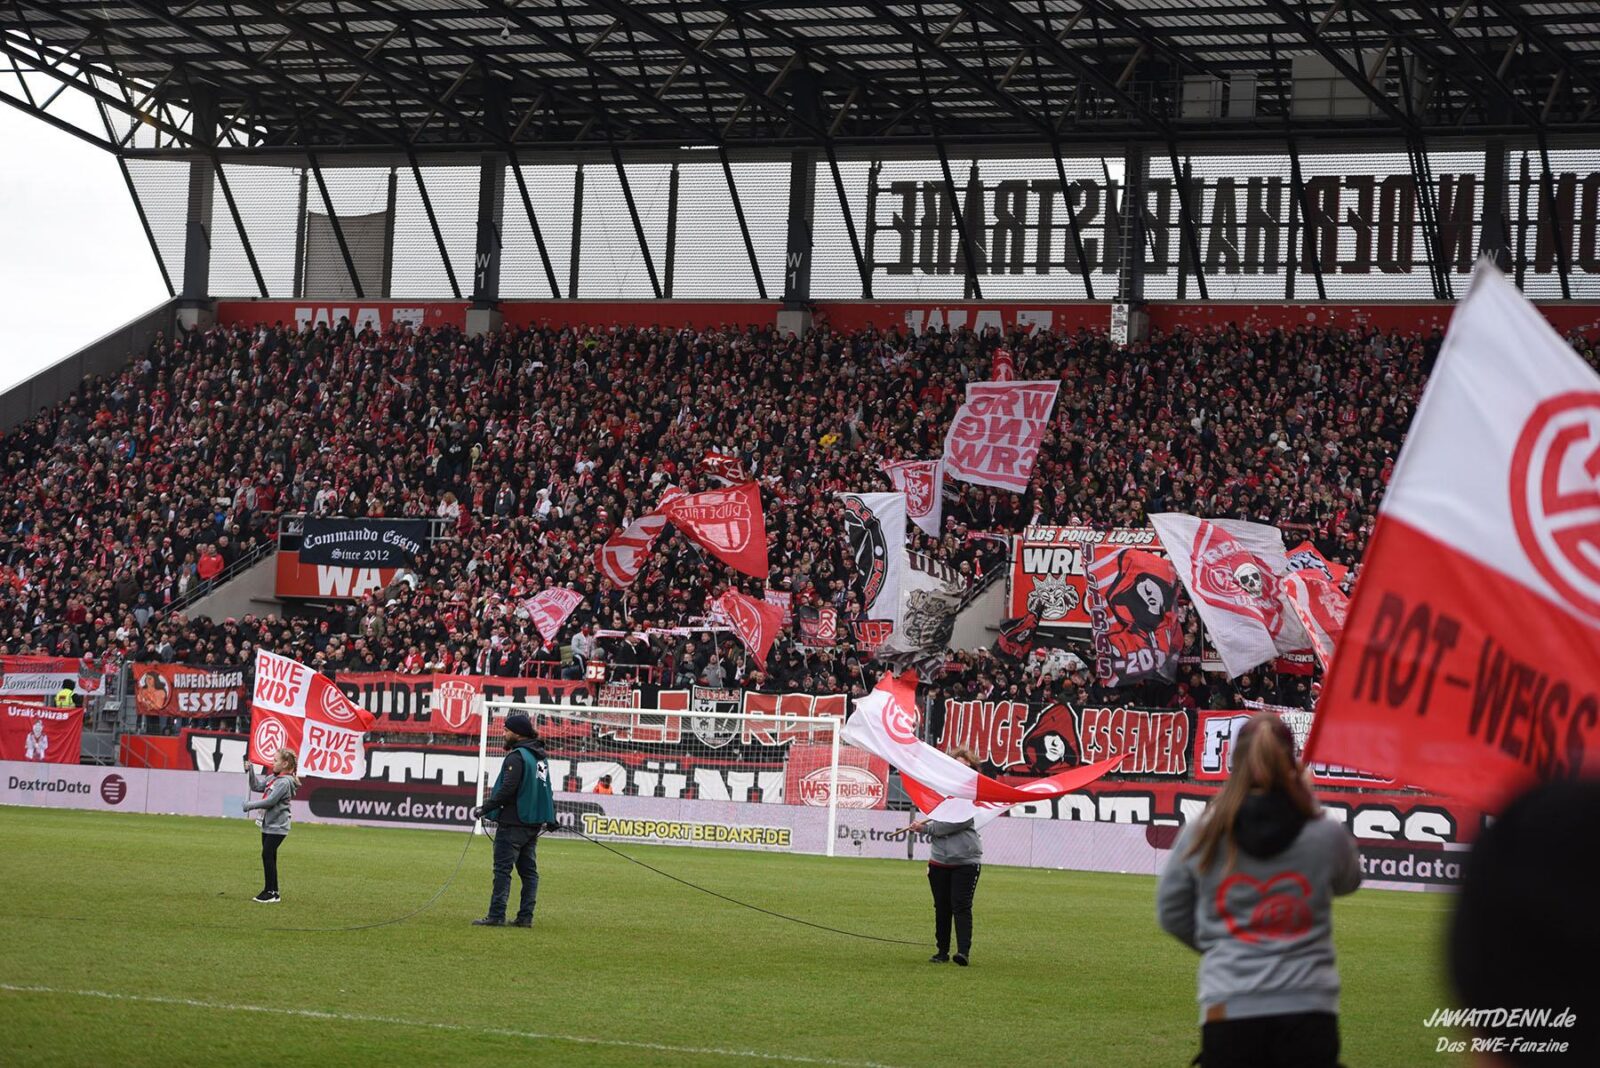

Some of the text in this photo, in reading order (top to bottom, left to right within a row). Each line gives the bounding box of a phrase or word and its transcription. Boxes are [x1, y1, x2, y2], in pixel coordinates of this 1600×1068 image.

[304, 527, 420, 555] Commando Essen
[1027, 528, 1056, 542] LOS
[1106, 530, 1157, 544] LOCOS
[331, 548, 390, 561] Since 2012
[317, 564, 404, 598] WA
[3, 675, 63, 690] Kommiliton
[258, 654, 306, 686] RWE
[178, 691, 239, 712] ESSEN
[255, 677, 300, 708] KIDS
[309, 726, 359, 753] RWE
[937, 698, 1029, 769] JUNGE
[1081, 708, 1189, 774] ESSENER
[304, 747, 356, 774] KIDS
[8, 776, 91, 794] DextraData
[584, 814, 791, 846] TEAMSPORTBEDARF.DE
